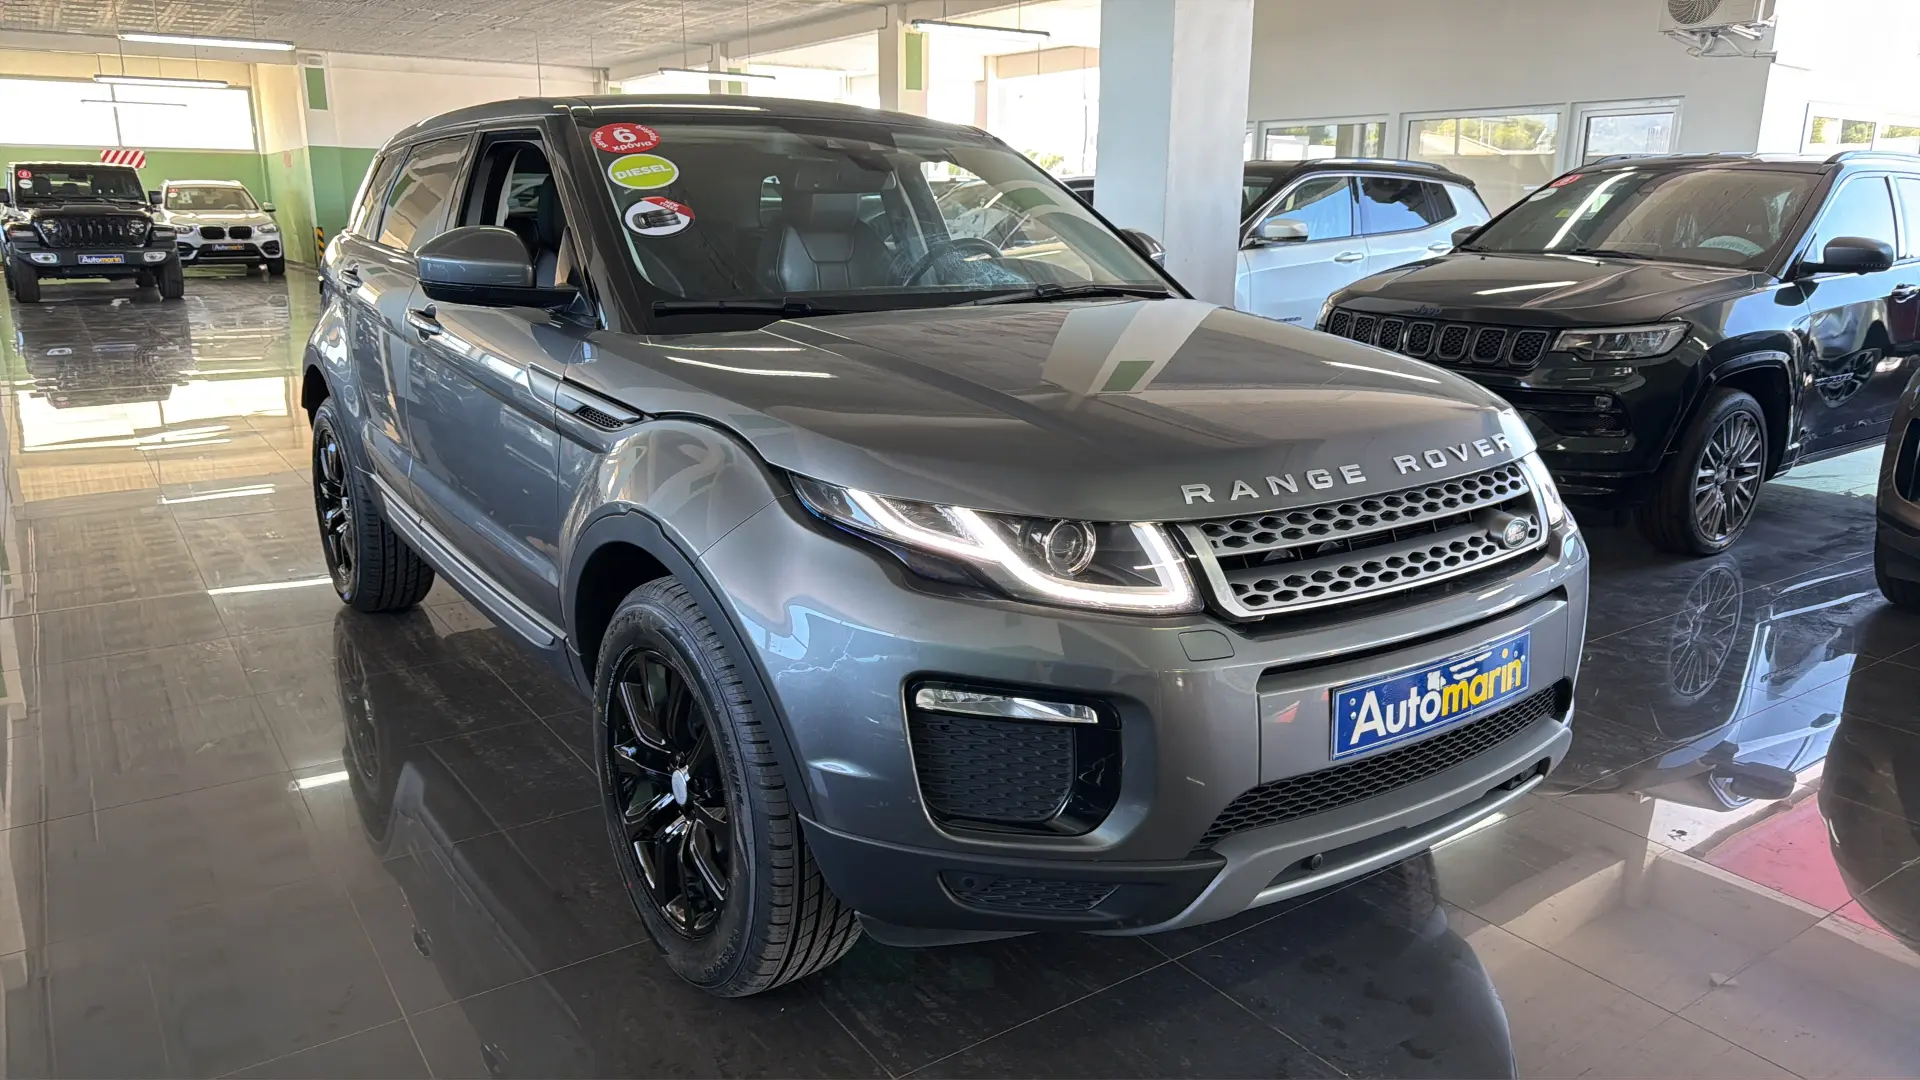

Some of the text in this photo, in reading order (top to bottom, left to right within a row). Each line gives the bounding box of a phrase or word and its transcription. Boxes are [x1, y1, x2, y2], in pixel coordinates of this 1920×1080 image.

[613, 128, 637, 143] 6
[612, 140, 653, 151] χρόνια
[615, 164, 671, 180] DIESEL
[81, 255, 122, 263] Automarin
[1180, 432, 1512, 505] RANGE ROVER
[1349, 647, 1522, 745] Automarin
